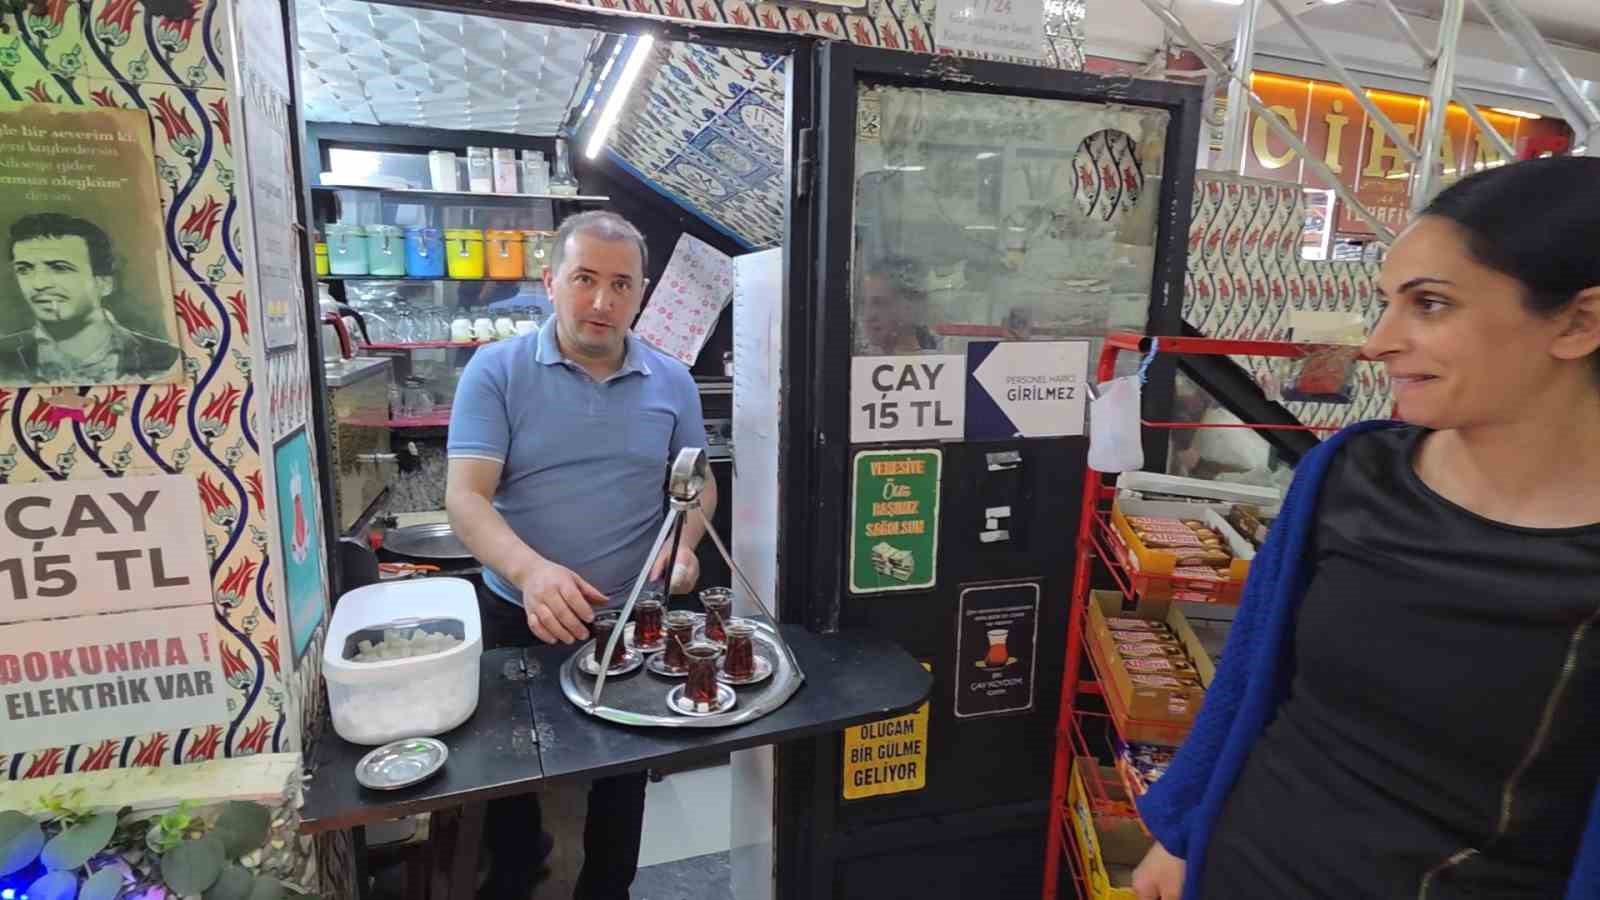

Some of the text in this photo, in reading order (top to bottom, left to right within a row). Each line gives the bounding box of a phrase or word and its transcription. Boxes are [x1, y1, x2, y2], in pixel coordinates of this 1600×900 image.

[21, 124, 48, 138] bir
[50, 129, 114, 142] severim
[872, 364, 945, 402] ÇAY
[1007, 385, 1075, 401] GİRİLMEZ
[862, 400, 953, 429] 15 TL
[4, 490, 160, 552] ÇAY
[0, 547, 190, 600] 15 TL
[0, 636, 188, 686] DOKUNMA
[5, 670, 215, 721] ELEKTRİK VAR
[851, 744, 873, 763] BİR
[853, 761, 917, 787] GELİYOR
